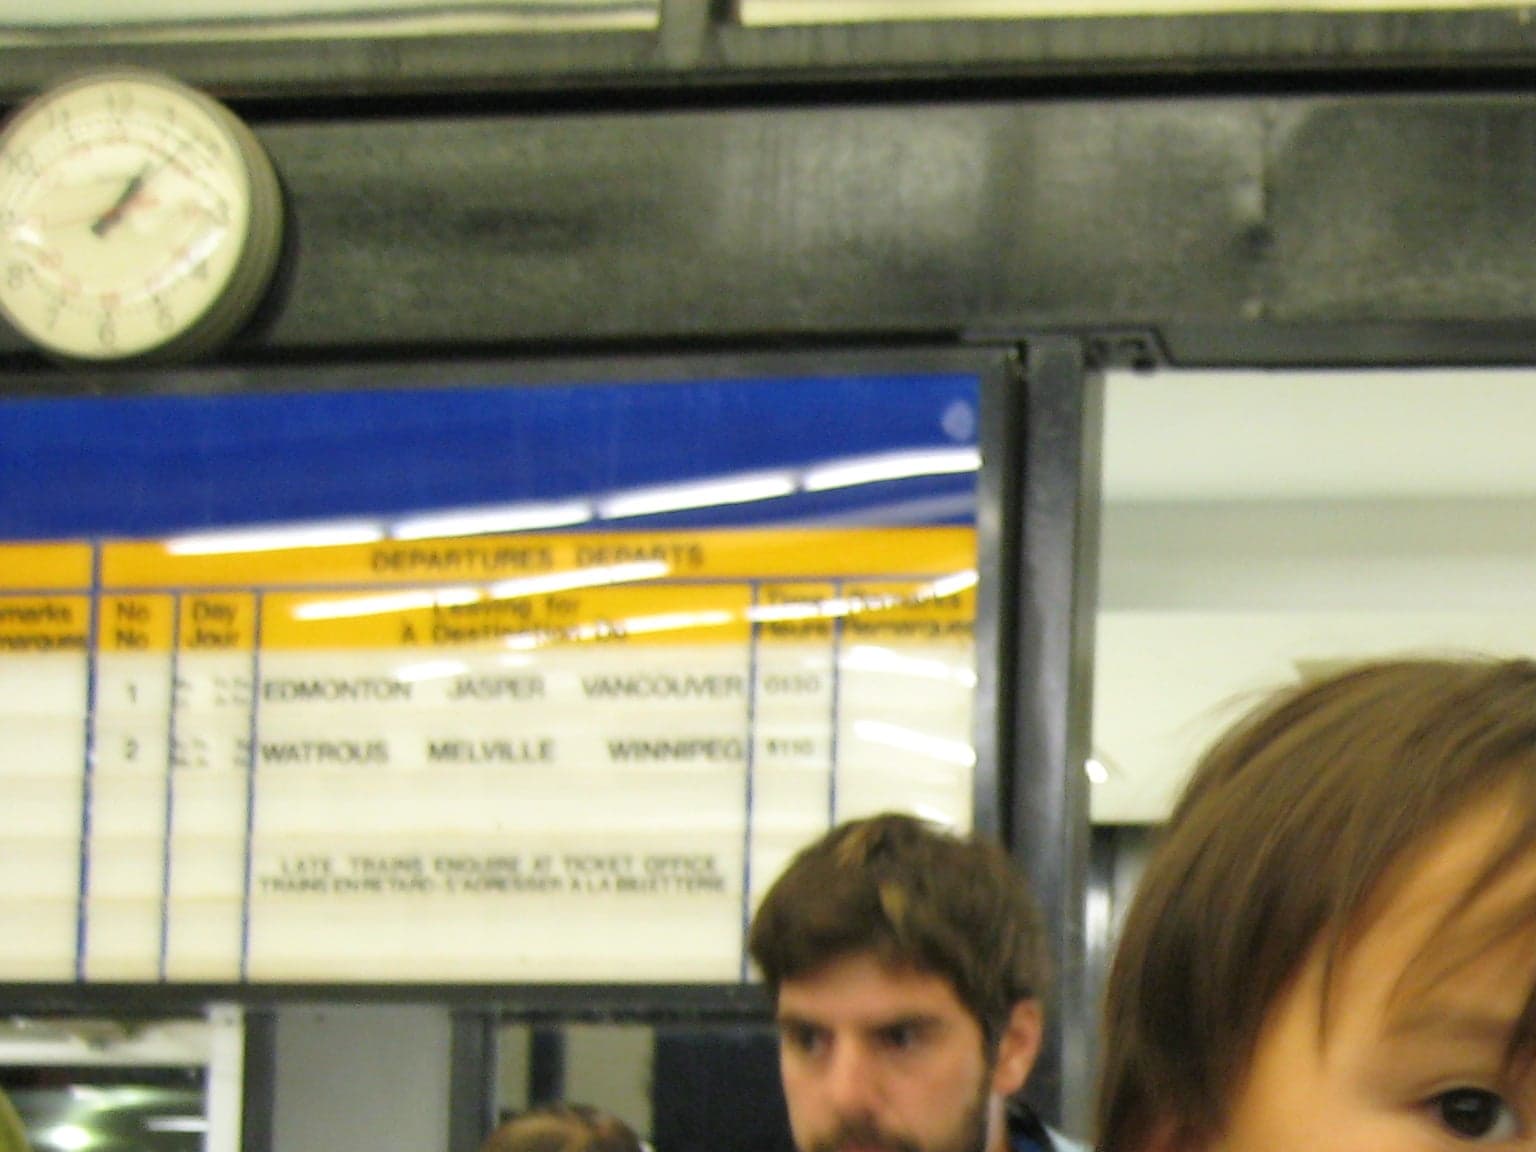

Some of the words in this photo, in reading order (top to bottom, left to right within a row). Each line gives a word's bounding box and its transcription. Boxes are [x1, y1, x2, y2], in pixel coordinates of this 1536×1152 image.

[372, 547, 551, 572] DEPARTURES
[263, 678, 411, 701] EDMONTON
[449, 675, 546, 699] JASPER
[581, 674, 743, 698] VANCOUVER
[262, 740, 389, 763] WATROUS
[428, 738, 555, 762] MELVILLE
[608, 737, 745, 761] WINNIPEG
